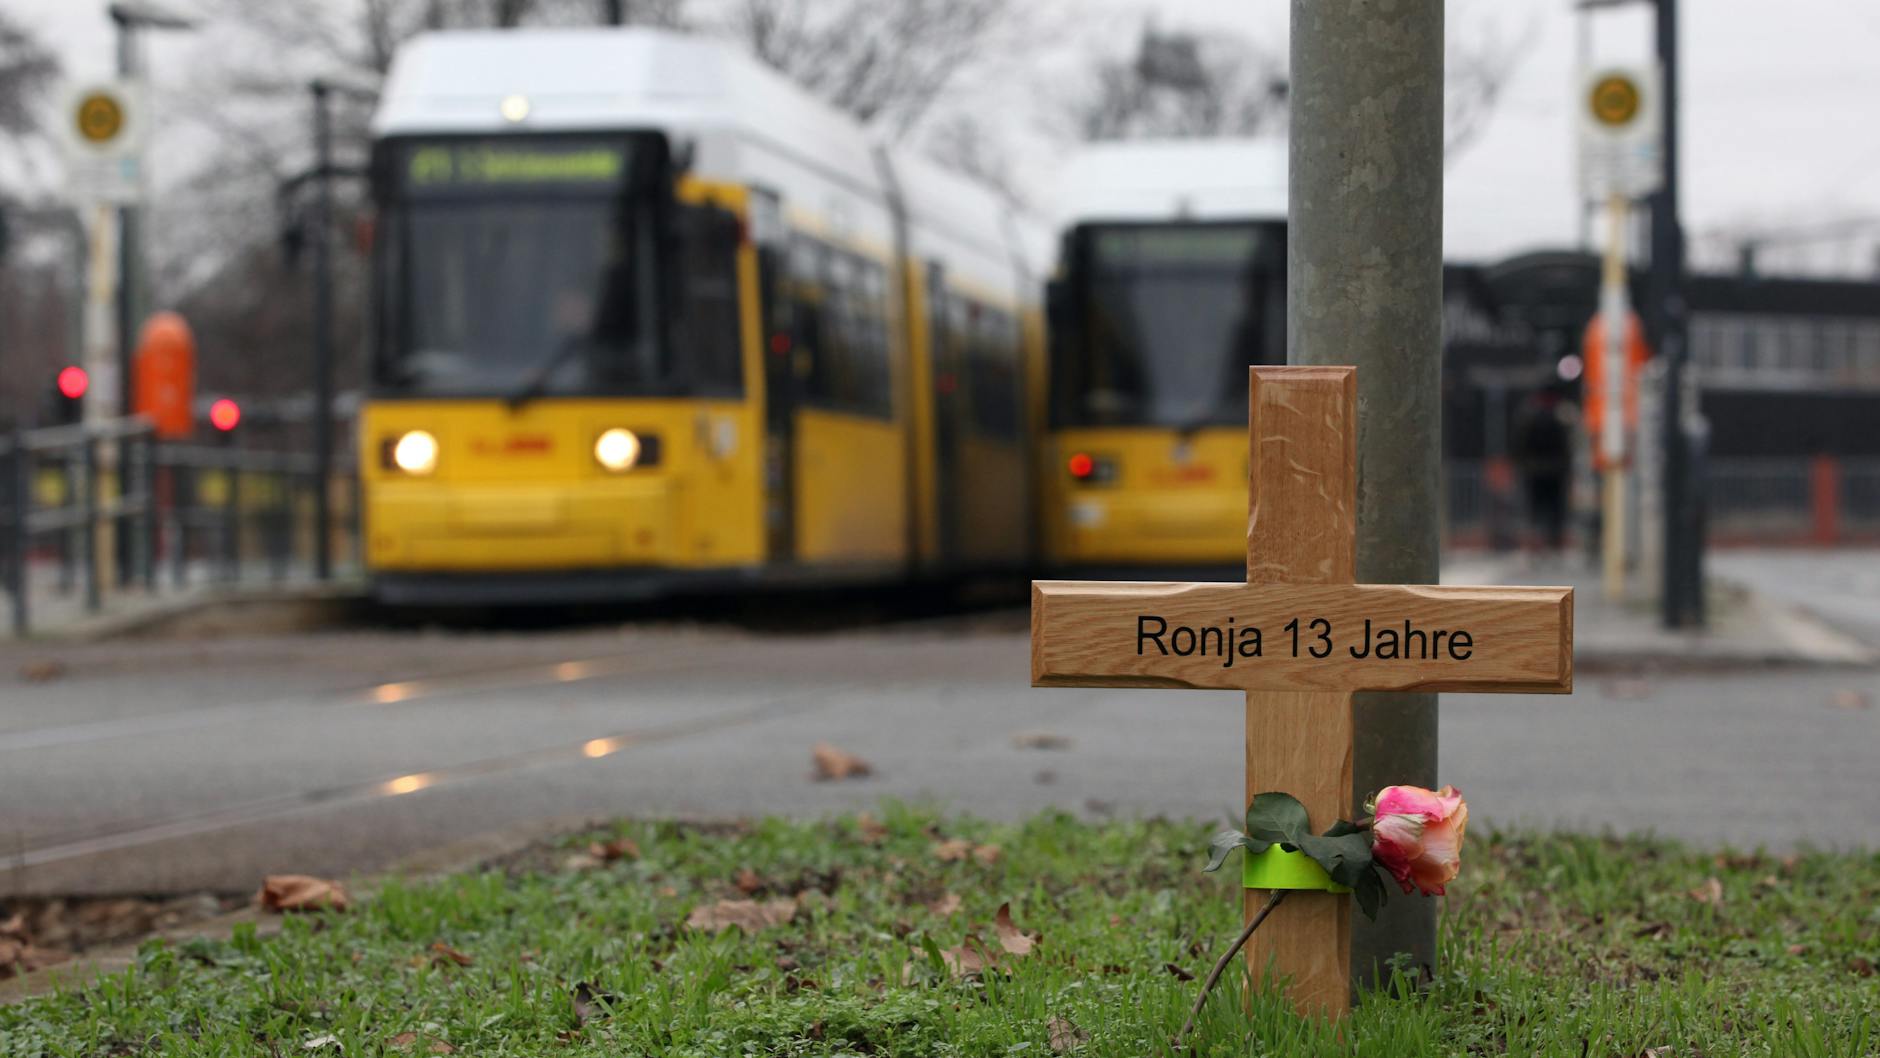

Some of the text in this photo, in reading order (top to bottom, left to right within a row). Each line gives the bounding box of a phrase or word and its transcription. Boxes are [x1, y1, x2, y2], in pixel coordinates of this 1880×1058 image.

[1136, 615, 1474, 668] Ronja 13 Jahre
